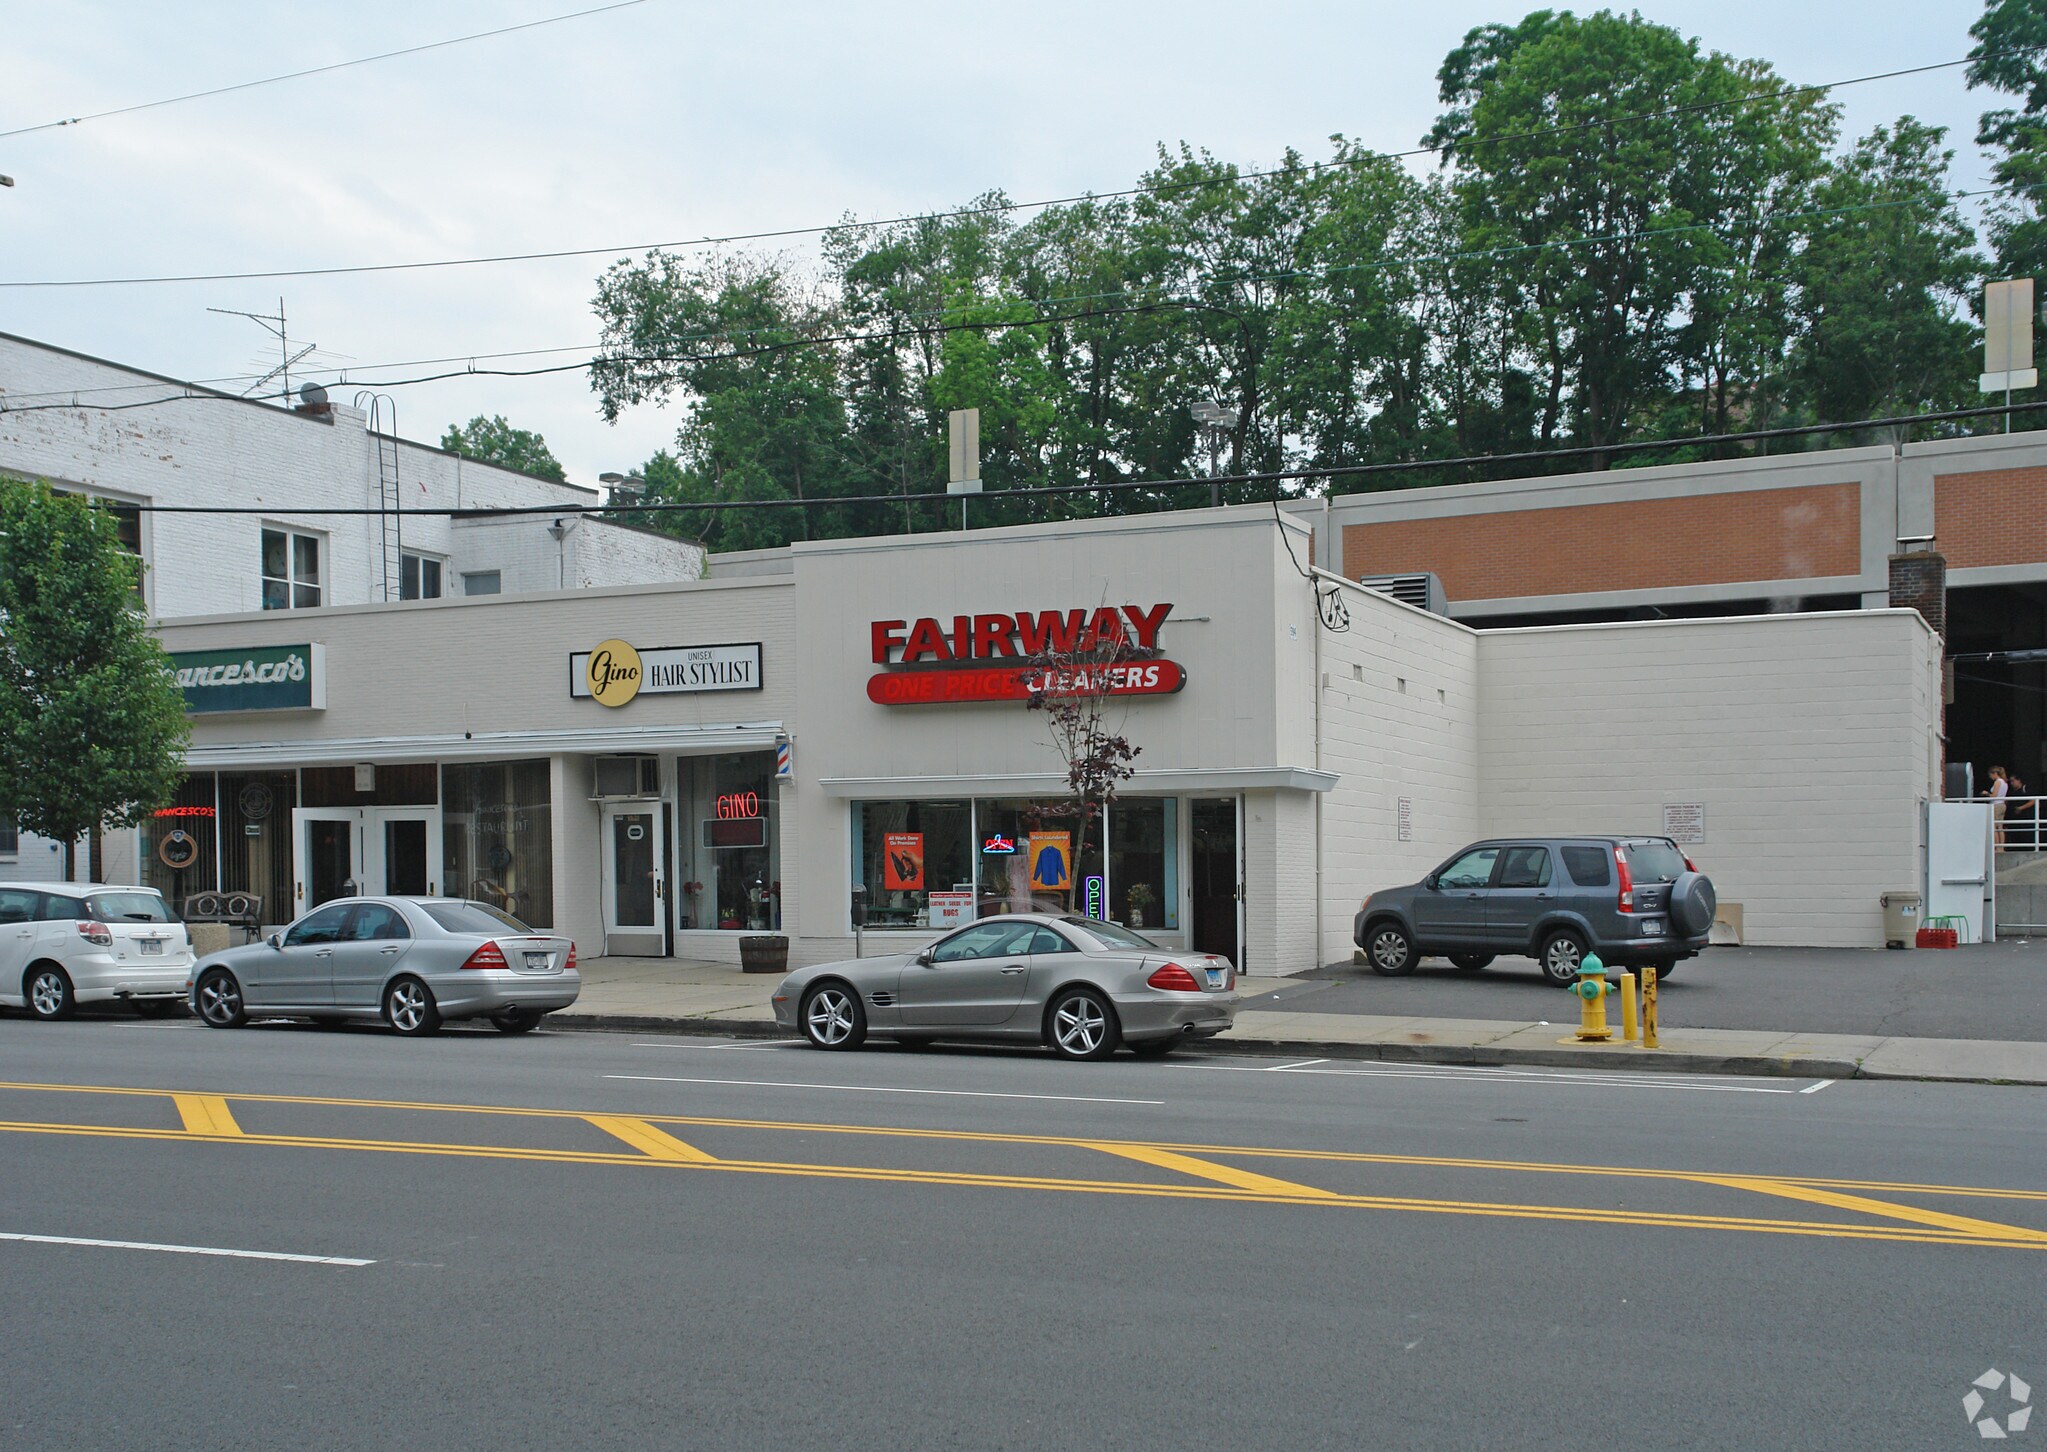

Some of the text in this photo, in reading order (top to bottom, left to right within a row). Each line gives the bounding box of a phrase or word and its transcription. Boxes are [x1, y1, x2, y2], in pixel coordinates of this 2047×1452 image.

[871, 603, 1174, 664] FAIRWAY
[687, 650, 713, 662] UNISEX
[591, 650, 639, 696] Gino
[651, 660, 752, 688] HAIR STYLIST
[884, 676, 933, 699] ONE
[945, 673, 1016, 697] PRICE
[148, 805, 216, 818] RANCESCO'S
[717, 791, 758, 820] GINO
[942, 909, 959, 917] RUGS
